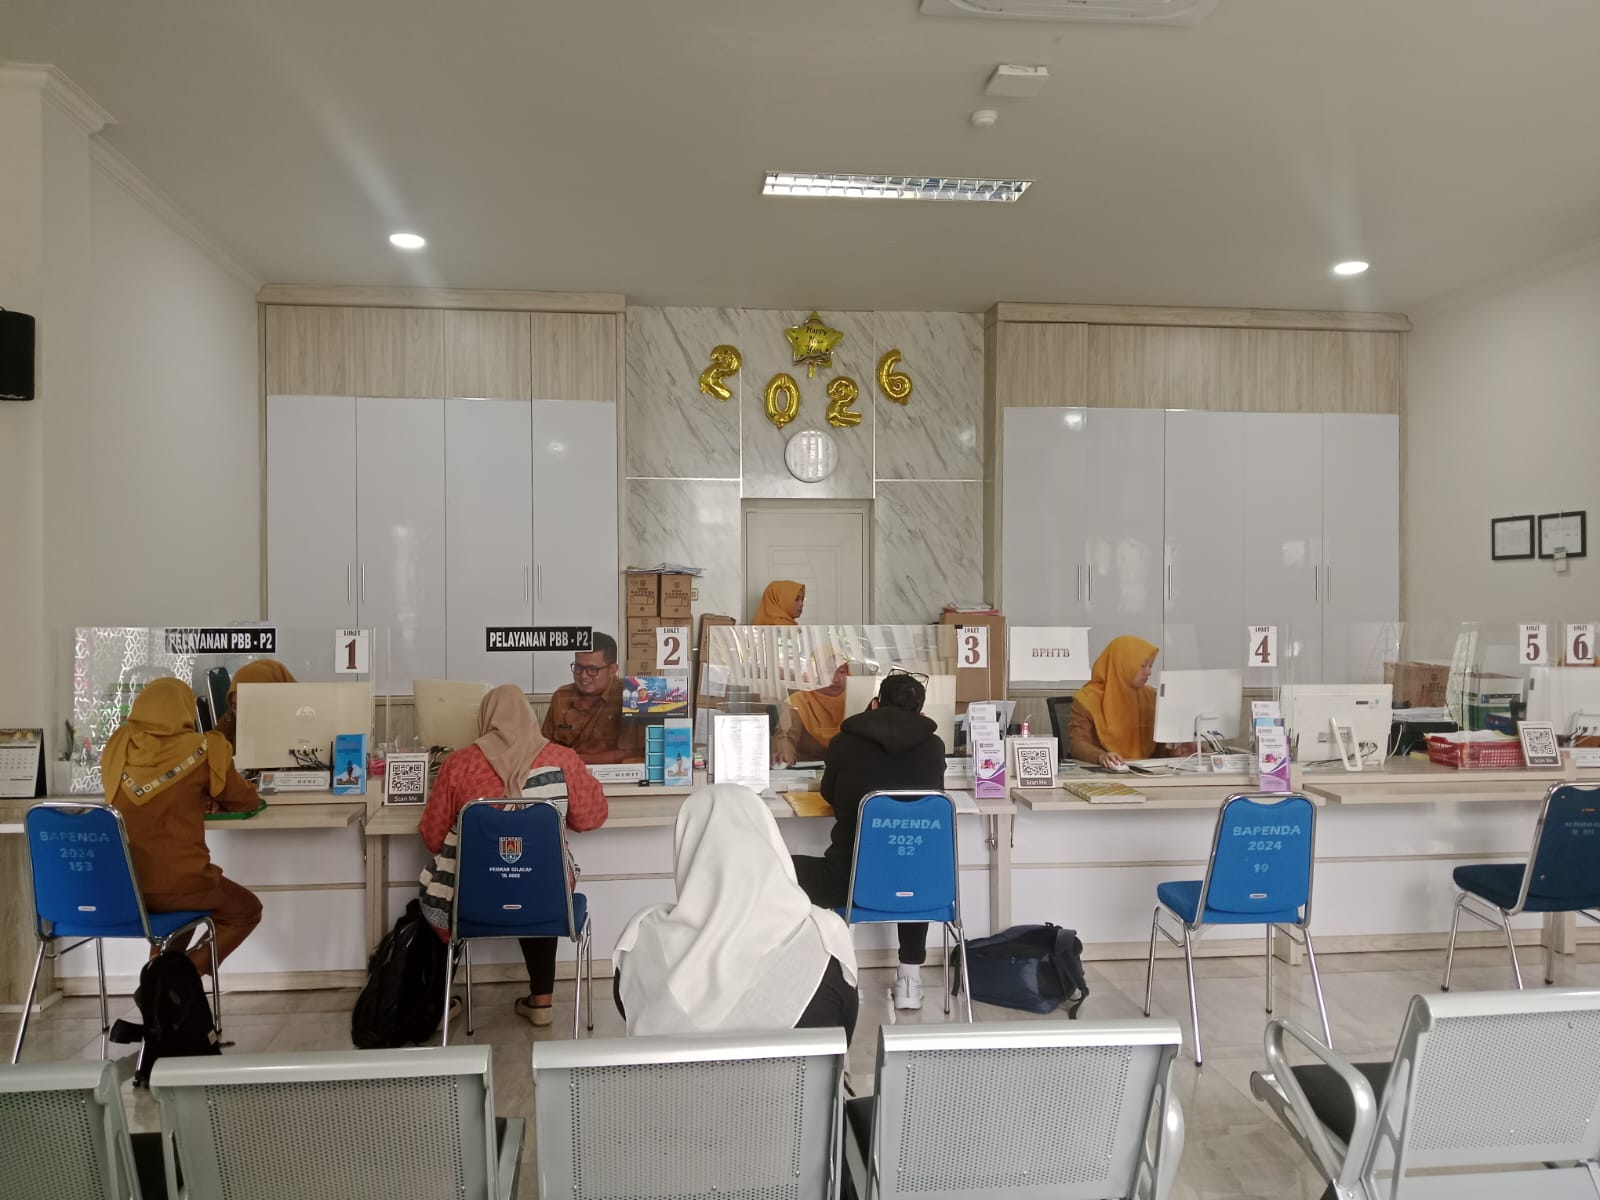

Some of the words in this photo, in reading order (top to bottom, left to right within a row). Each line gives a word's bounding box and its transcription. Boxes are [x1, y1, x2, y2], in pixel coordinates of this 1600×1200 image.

[806, 326, 827, 336] Happy
[231, 632, 252, 649] PBB
[260, 632, 273, 649] P2
[489, 631, 546, 648] PELAYANAN
[549, 631, 569, 647] PBB
[576, 631, 589, 647] P2
[1525, 633, 1540, 661] 5
[1573, 633, 1589, 661] 6
[344, 638, 357, 670] 1
[663, 636, 681, 666] 2
[964, 635, 980, 665] 3
[1031, 648, 1070, 658] BPHTB
[1254, 634, 1271, 663] 4
[871, 818, 942, 830] BAPENDA
[1232, 825, 1301, 836] BAPENDA
[40, 831, 110, 842] BAPENDA
[887, 834, 923, 845] 2024
[1247, 840, 1282, 851] 2024
